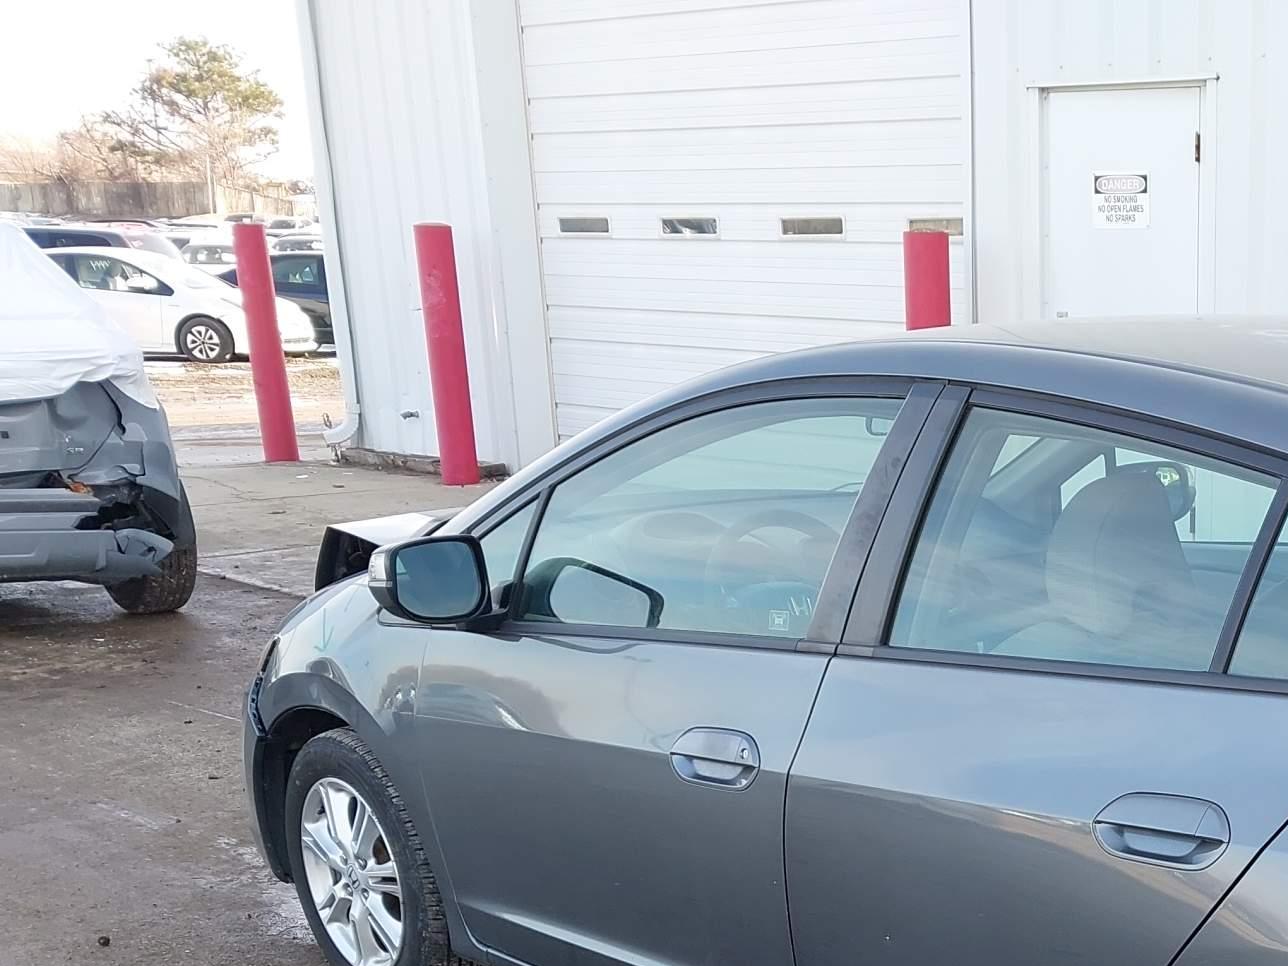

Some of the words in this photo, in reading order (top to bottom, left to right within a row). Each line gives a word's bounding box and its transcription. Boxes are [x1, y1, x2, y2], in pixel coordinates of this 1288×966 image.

[1101, 179, 1140, 190] DANGER
[1104, 195, 1112, 203] NO
[1113, 195, 1138, 203] SMOKING
[1098, 205, 1106, 213] NO
[1107, 205, 1121, 213] OPEN
[1122, 204, 1144, 212] FLAMES
[1105, 214, 1113, 222] NO
[1115, 214, 1136, 222] SPARKS
